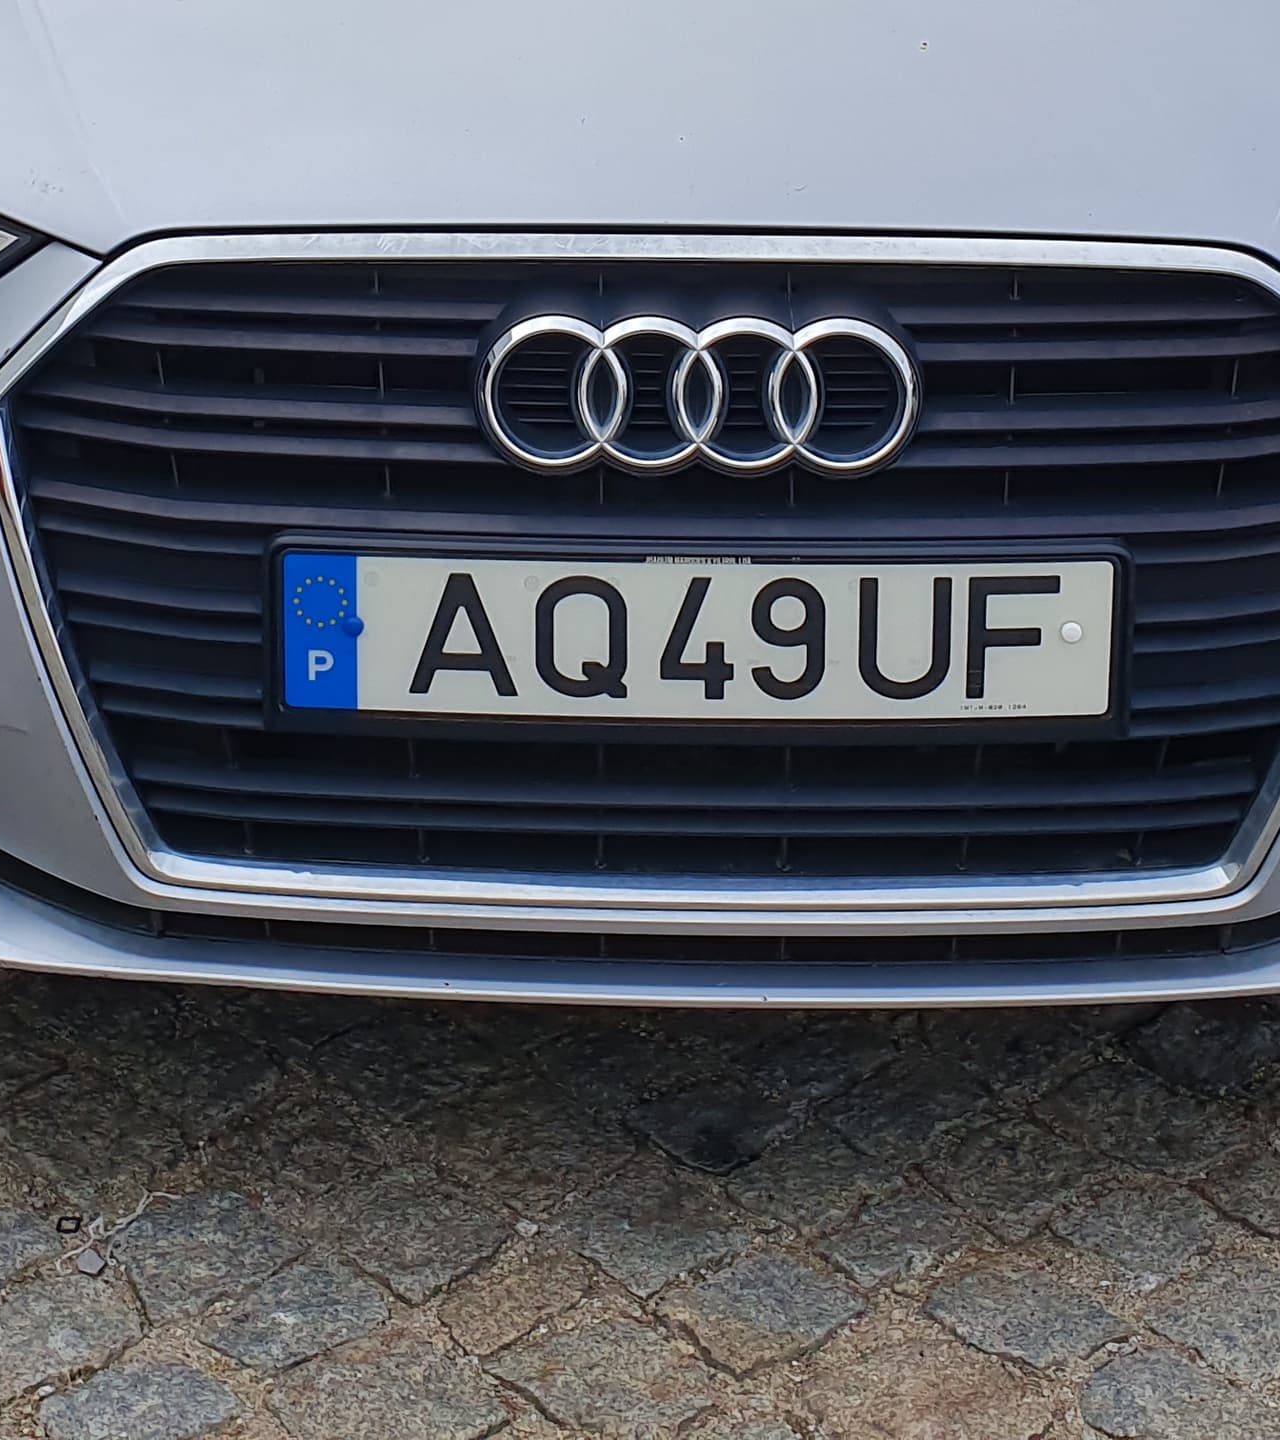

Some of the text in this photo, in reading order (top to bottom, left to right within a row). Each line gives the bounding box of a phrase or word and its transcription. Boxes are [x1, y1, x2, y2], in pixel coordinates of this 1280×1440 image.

[308, 649, 334, 681] P
[408, 572, 1062, 701] AQ 49 UF
